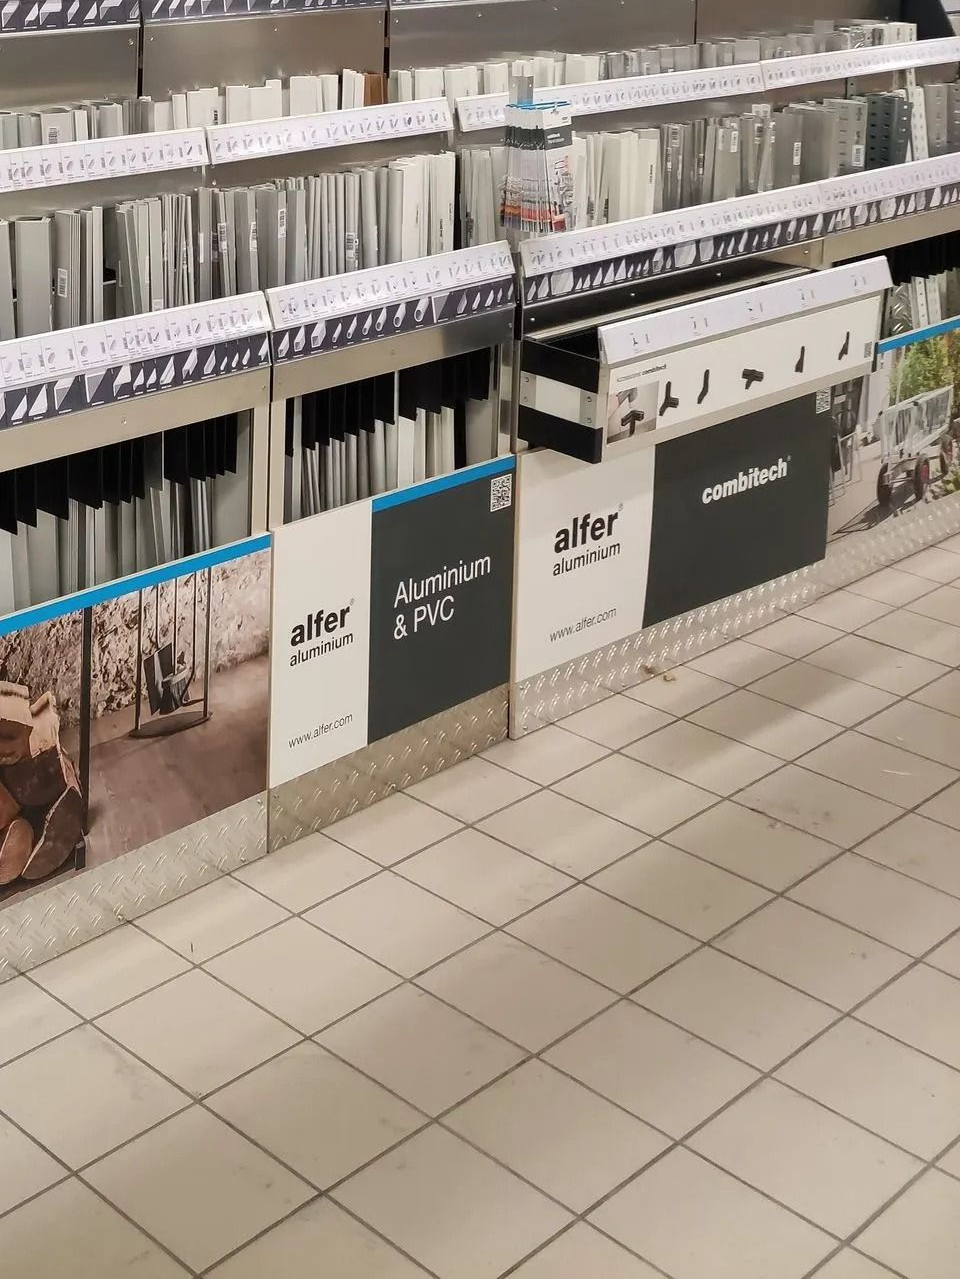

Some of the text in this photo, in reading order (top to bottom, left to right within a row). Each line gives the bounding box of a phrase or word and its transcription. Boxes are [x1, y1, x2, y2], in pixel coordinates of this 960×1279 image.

[552, 542, 621, 576] aluminium
[393, 555, 491, 608] Aluminium
[393, 595, 455, 640] & PVC
[549, 607, 617, 642] www.alfer.com
[290, 631, 354, 666] aluminium
[288, 713, 353, 748] www.alfer.com
